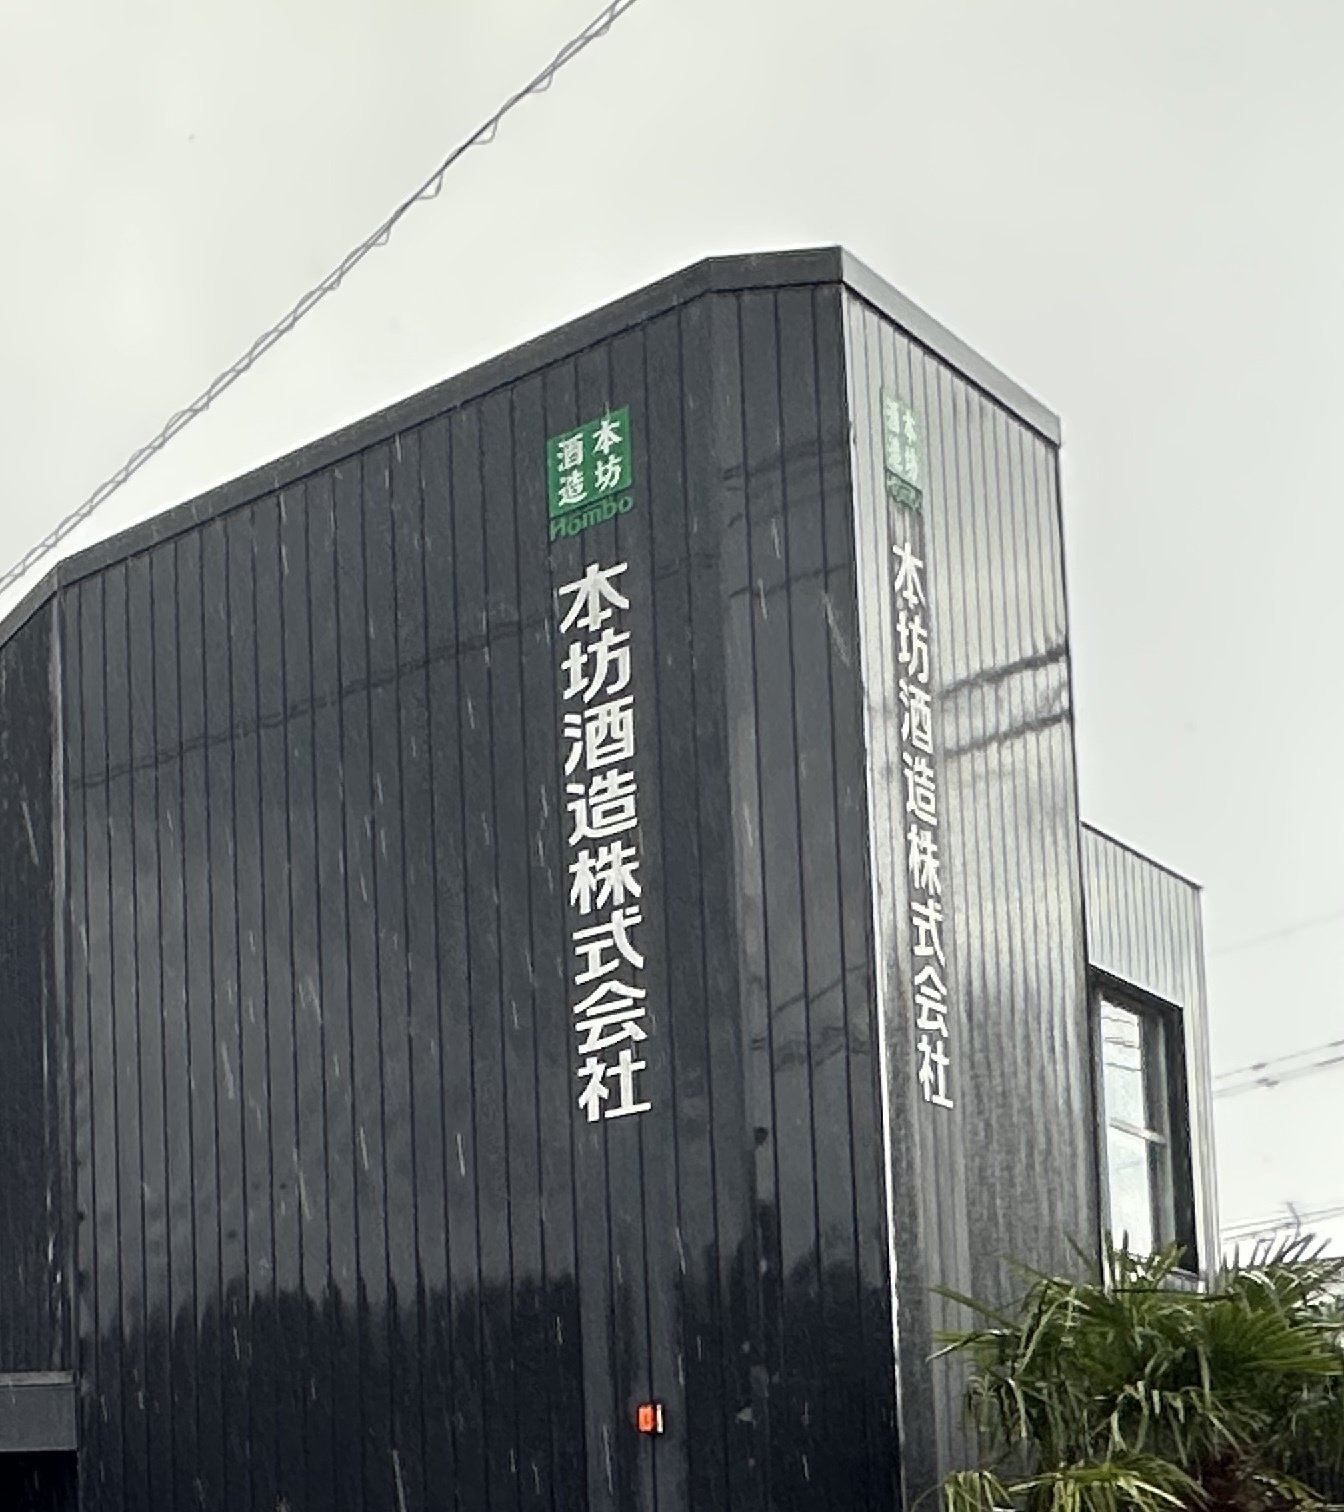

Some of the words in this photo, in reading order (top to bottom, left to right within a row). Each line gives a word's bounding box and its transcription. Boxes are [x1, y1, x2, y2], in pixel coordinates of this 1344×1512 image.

[549, 496, 634, 542] Hombo
[558, 561, 652, 1122] 本坊酒造株式会社
[891, 541, 954, 1110] 本坊酒造株式会社
